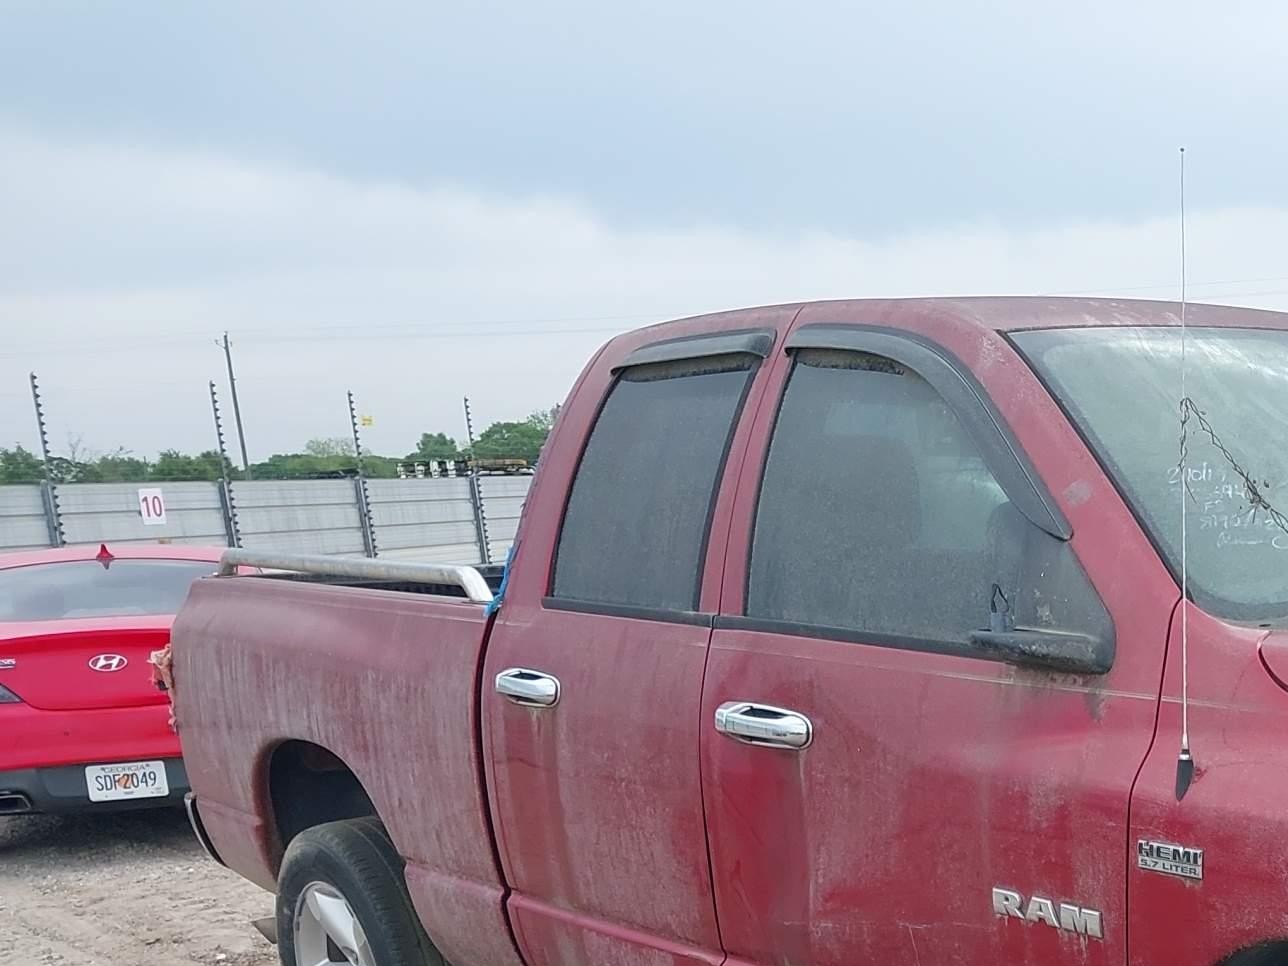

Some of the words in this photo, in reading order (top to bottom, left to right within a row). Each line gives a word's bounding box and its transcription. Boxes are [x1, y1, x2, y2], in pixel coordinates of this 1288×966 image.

[141, 495, 163, 517] 10
[95, 770, 157, 791] SDF2049
[1138, 841, 1200, 865] HEMI
[1140, 858, 1159, 869] 5.7
[1162, 862, 1198, 876] LITER
[992, 886, 1104, 939] RAM
